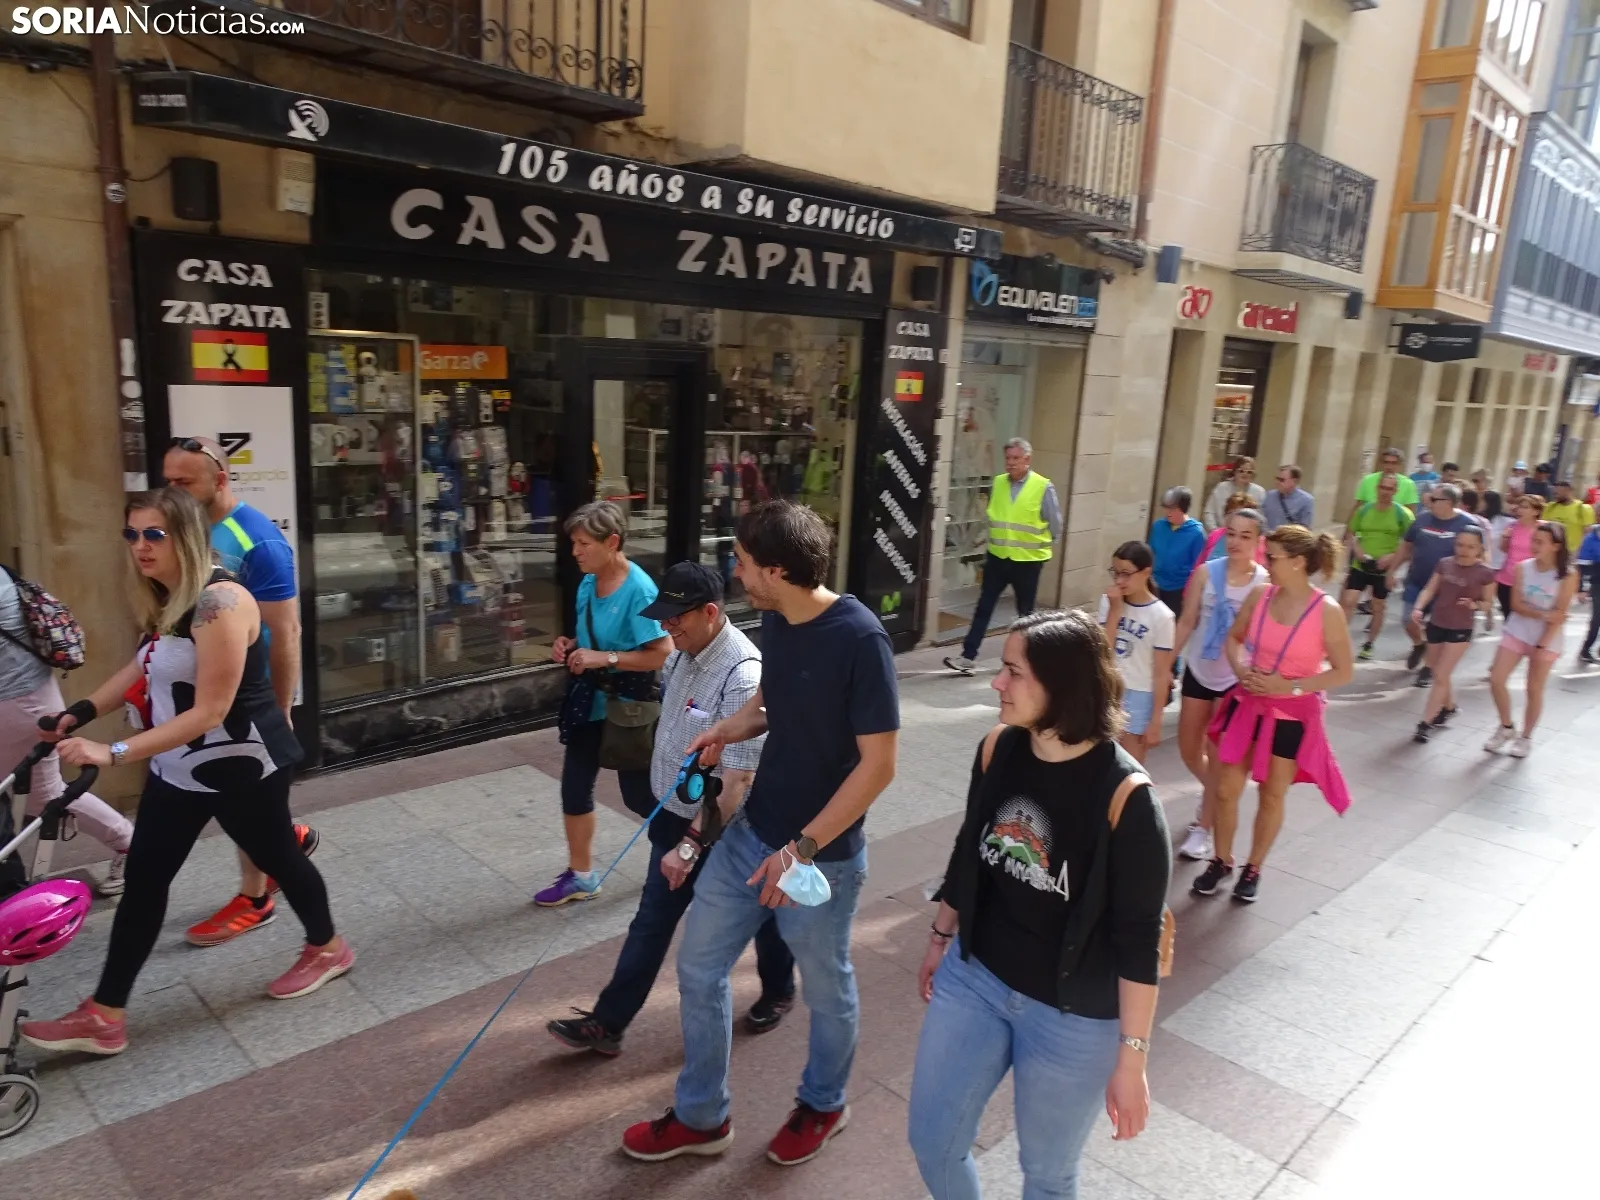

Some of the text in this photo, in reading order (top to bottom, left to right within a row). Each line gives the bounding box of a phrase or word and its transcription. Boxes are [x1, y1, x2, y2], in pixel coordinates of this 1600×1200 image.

[498, 142, 568, 183] 105
[588, 163, 685, 203] años
[700, 185, 722, 209] a
[390, 188, 873, 293] CASA ZAPATA
[177, 258, 274, 288] CASA
[160, 299, 292, 328] ZAPATA
[896, 320, 931, 337] CASA
[419, 350, 472, 370] Garza
[887, 344, 935, 361] ZAPATA
[881, 449, 922, 499] ANTENAS
[1116, 615, 1150, 640] ALE
